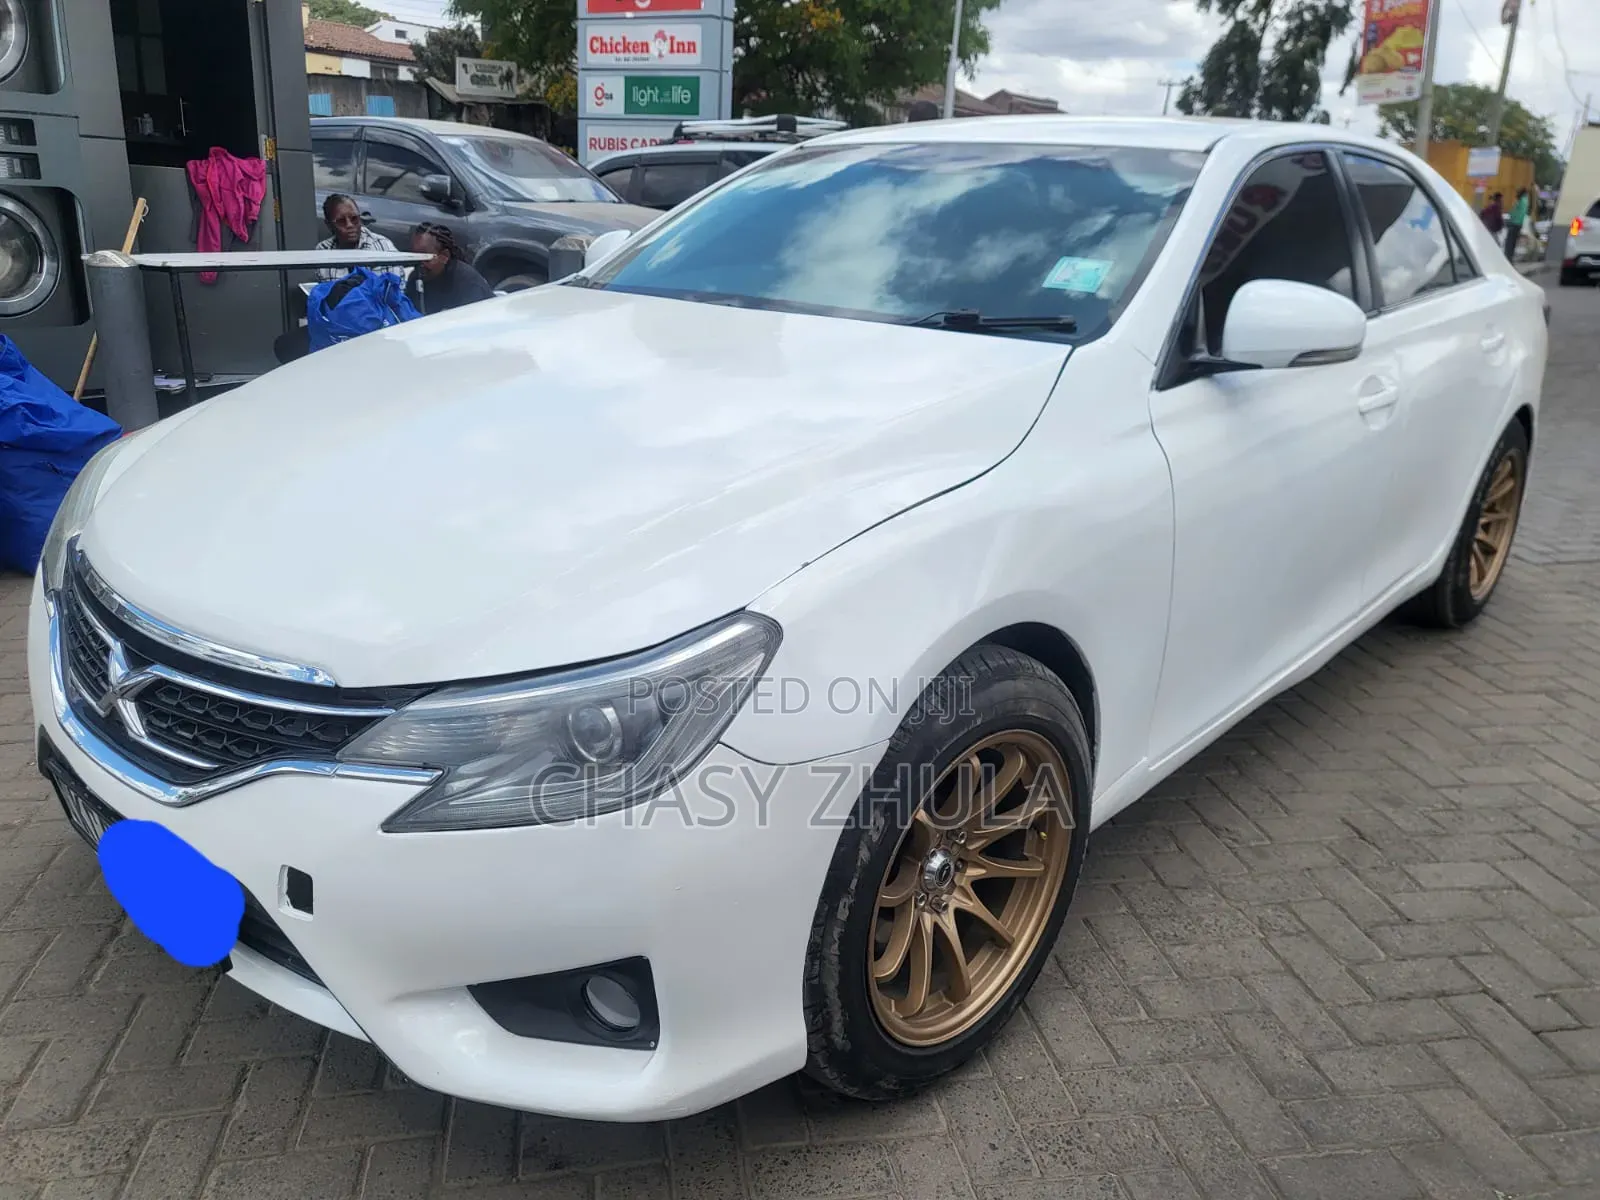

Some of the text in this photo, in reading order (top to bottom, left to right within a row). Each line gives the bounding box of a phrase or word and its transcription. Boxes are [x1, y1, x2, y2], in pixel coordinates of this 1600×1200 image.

[589, 34, 697, 55] Chicken Inn
[632, 85, 659, 107] light
[671, 85, 692, 104] life
[589, 137, 628, 151] RUBIS
